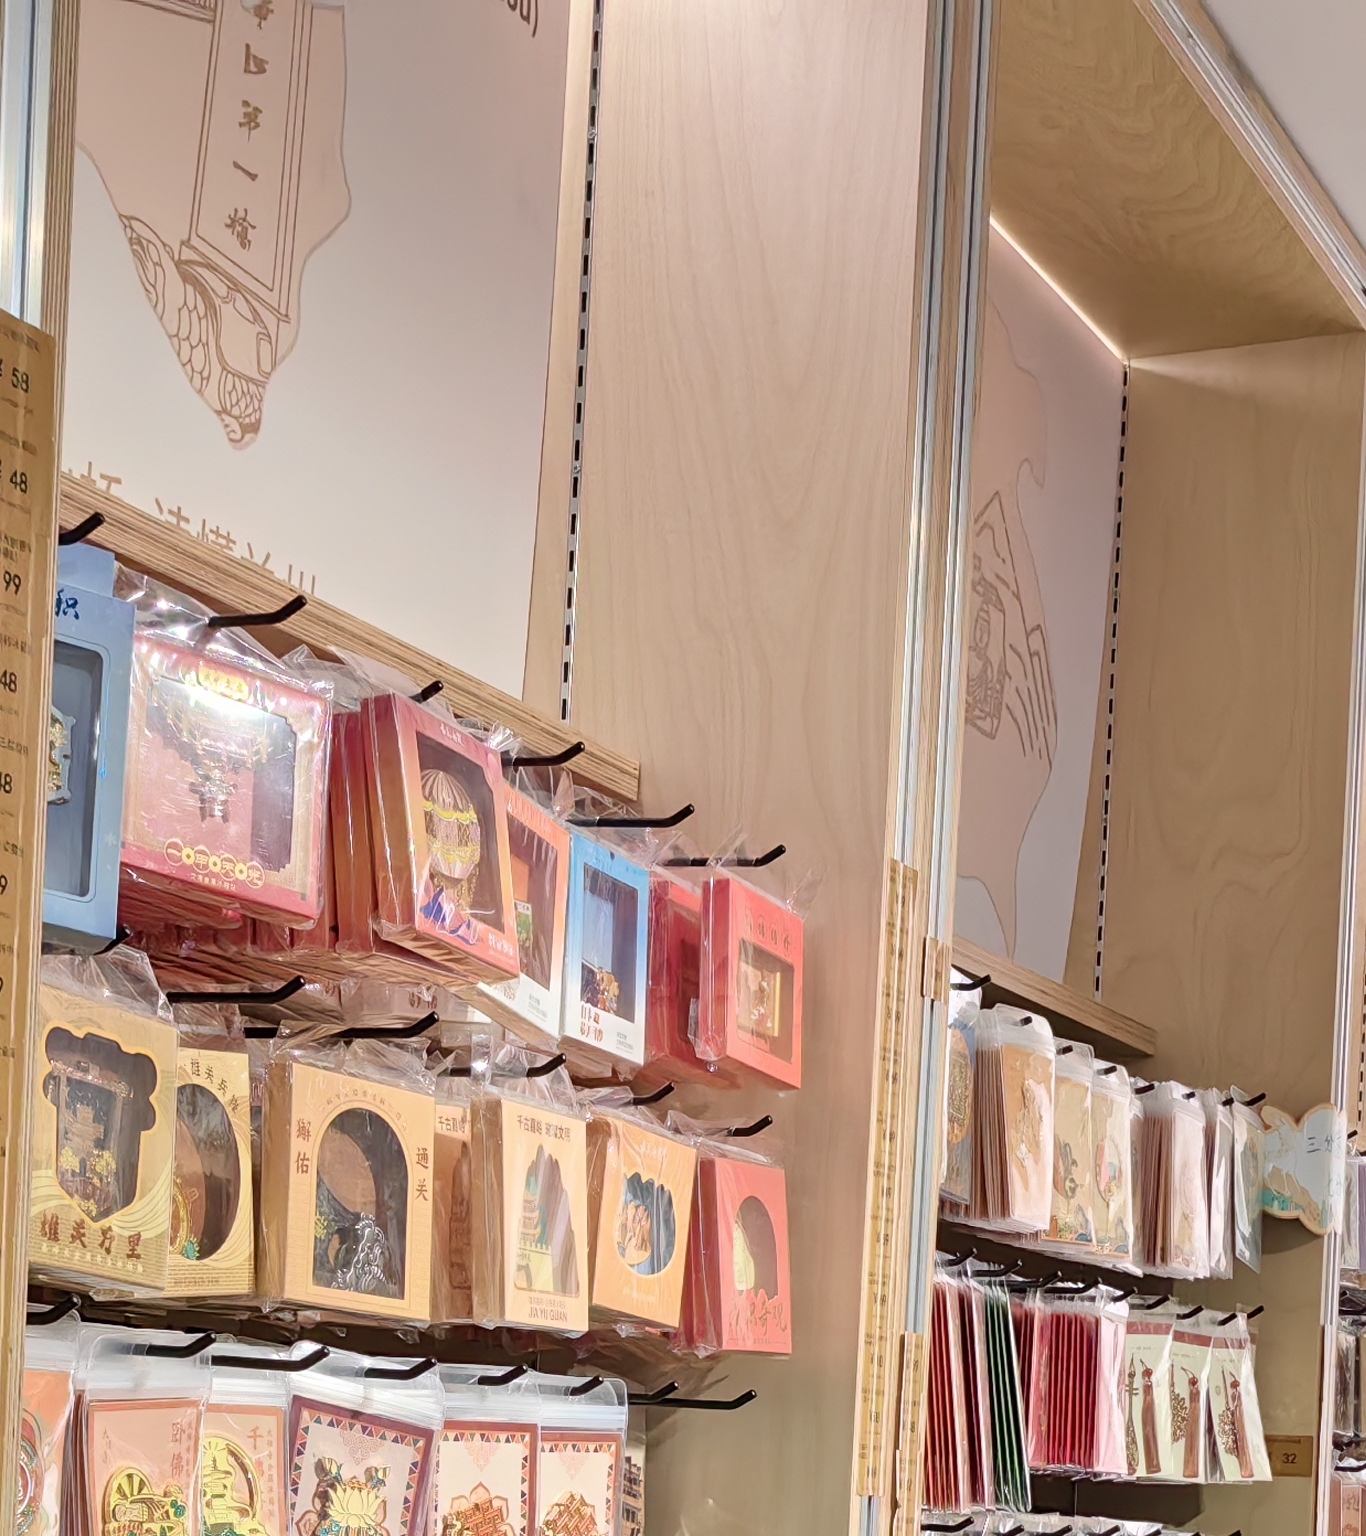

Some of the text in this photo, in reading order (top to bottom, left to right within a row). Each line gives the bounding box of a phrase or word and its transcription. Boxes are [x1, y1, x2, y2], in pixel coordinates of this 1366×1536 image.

[11, 367, 30, 393] 58
[9, 469, 28, 494] 48
[3, 571, 22, 595] 99
[0, 669, 18, 693] 48
[414, 1146, 430, 1203] 通关
[1282, 1452, 1298, 1465] 32
